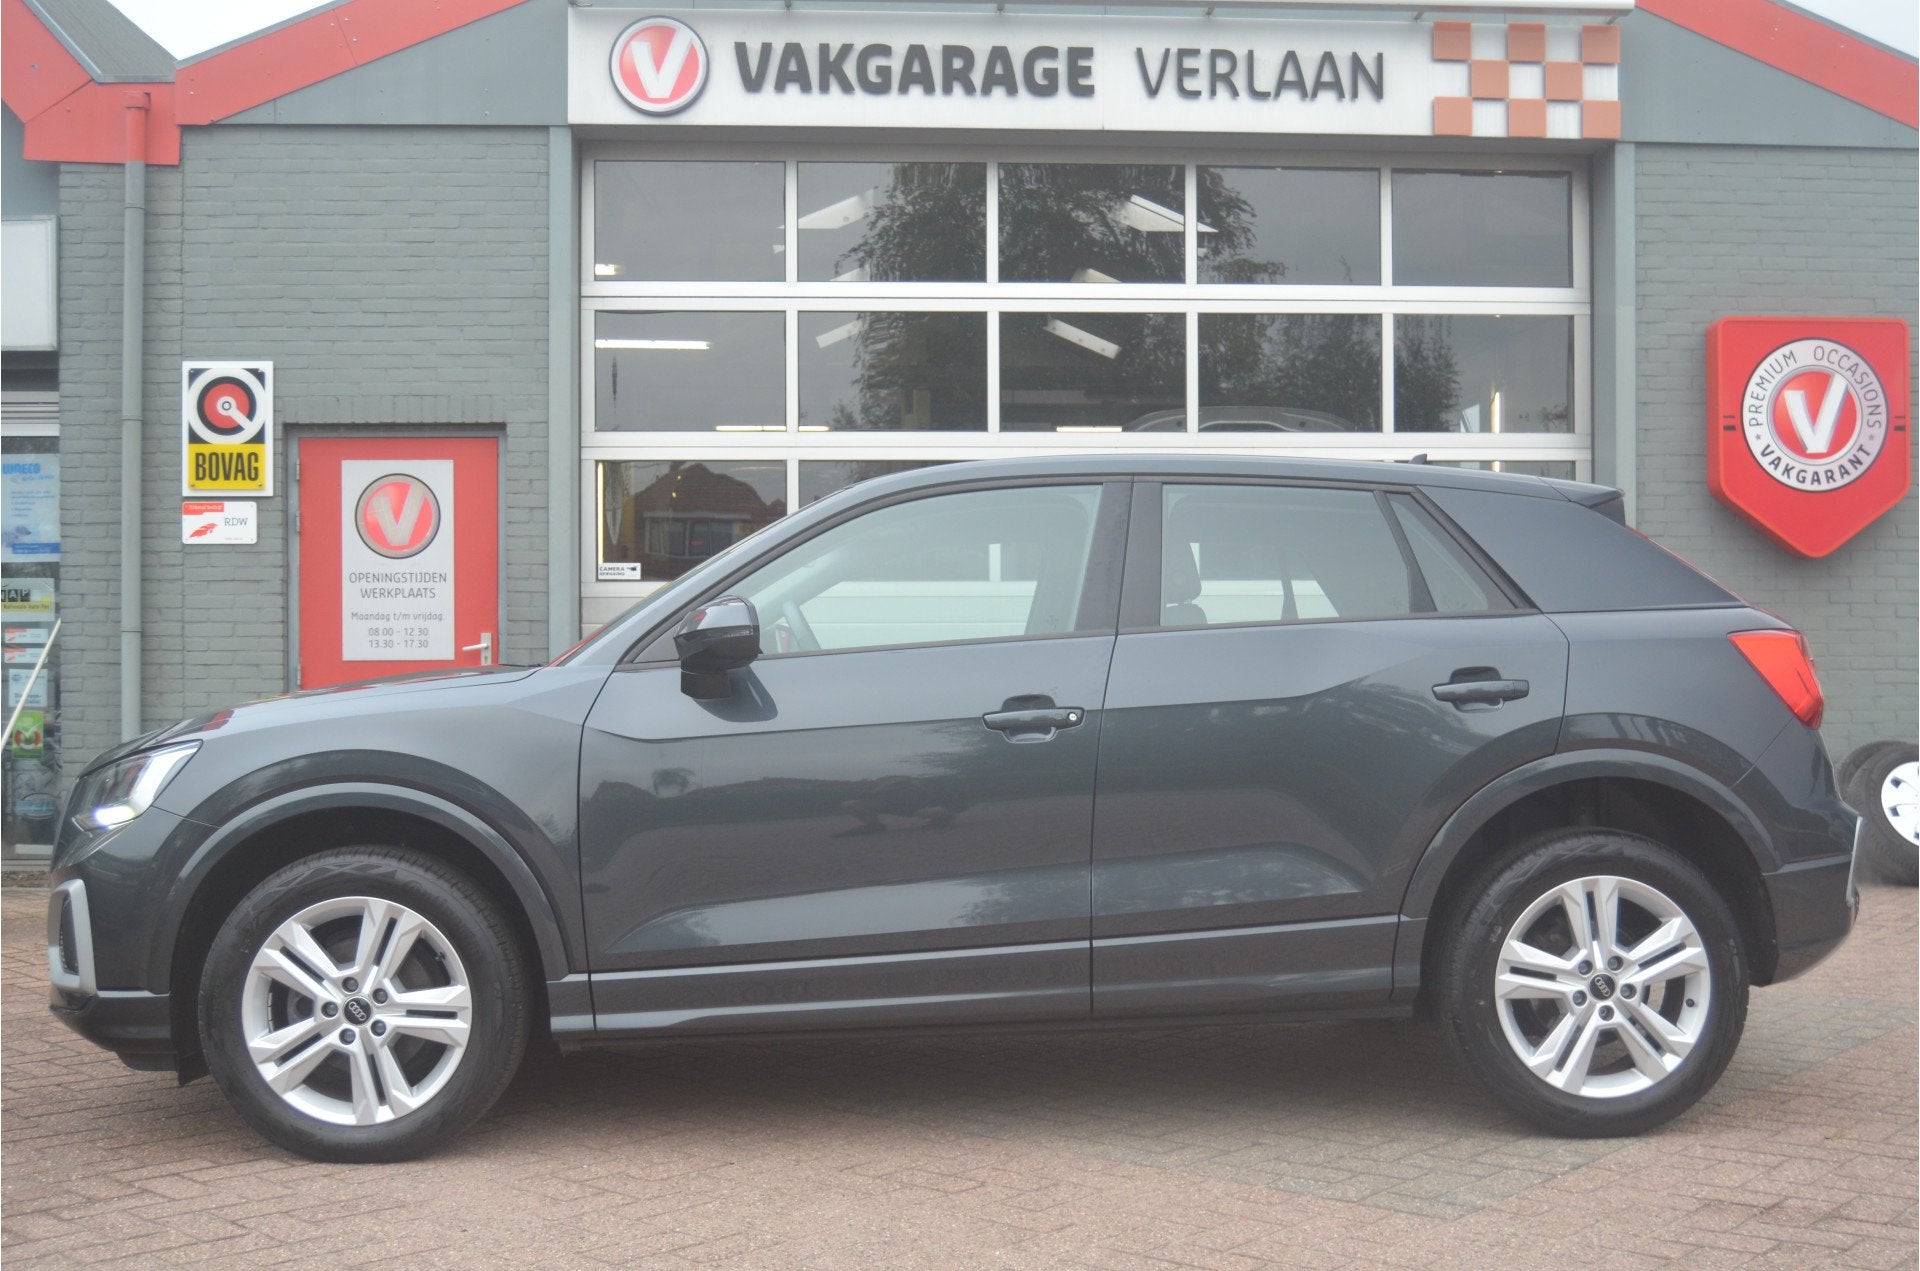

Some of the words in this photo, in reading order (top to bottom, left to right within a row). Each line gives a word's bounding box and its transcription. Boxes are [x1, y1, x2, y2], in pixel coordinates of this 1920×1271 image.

[734, 41, 1095, 97] VAKGARAGE
[1136, 47, 1384, 99] VERLAAN
[1749, 350, 1798, 428] PREMIUM
[1813, 345, 1882, 430] OCCASIONS
[195, 452, 259, 481] BOVAG
[1759, 444, 1871, 486] VAKGARANT
[224, 517, 248, 526] RDW
[349, 572, 447, 583] OPENINGSTIJDEN
[360, 587, 436, 598] WERKPLAATS
[351, 612, 391, 622] Maandag
[393, 612, 410, 621] t/m
[404, 627, 429, 637] 12.30
[404, 639, 429, 648] 17.30
